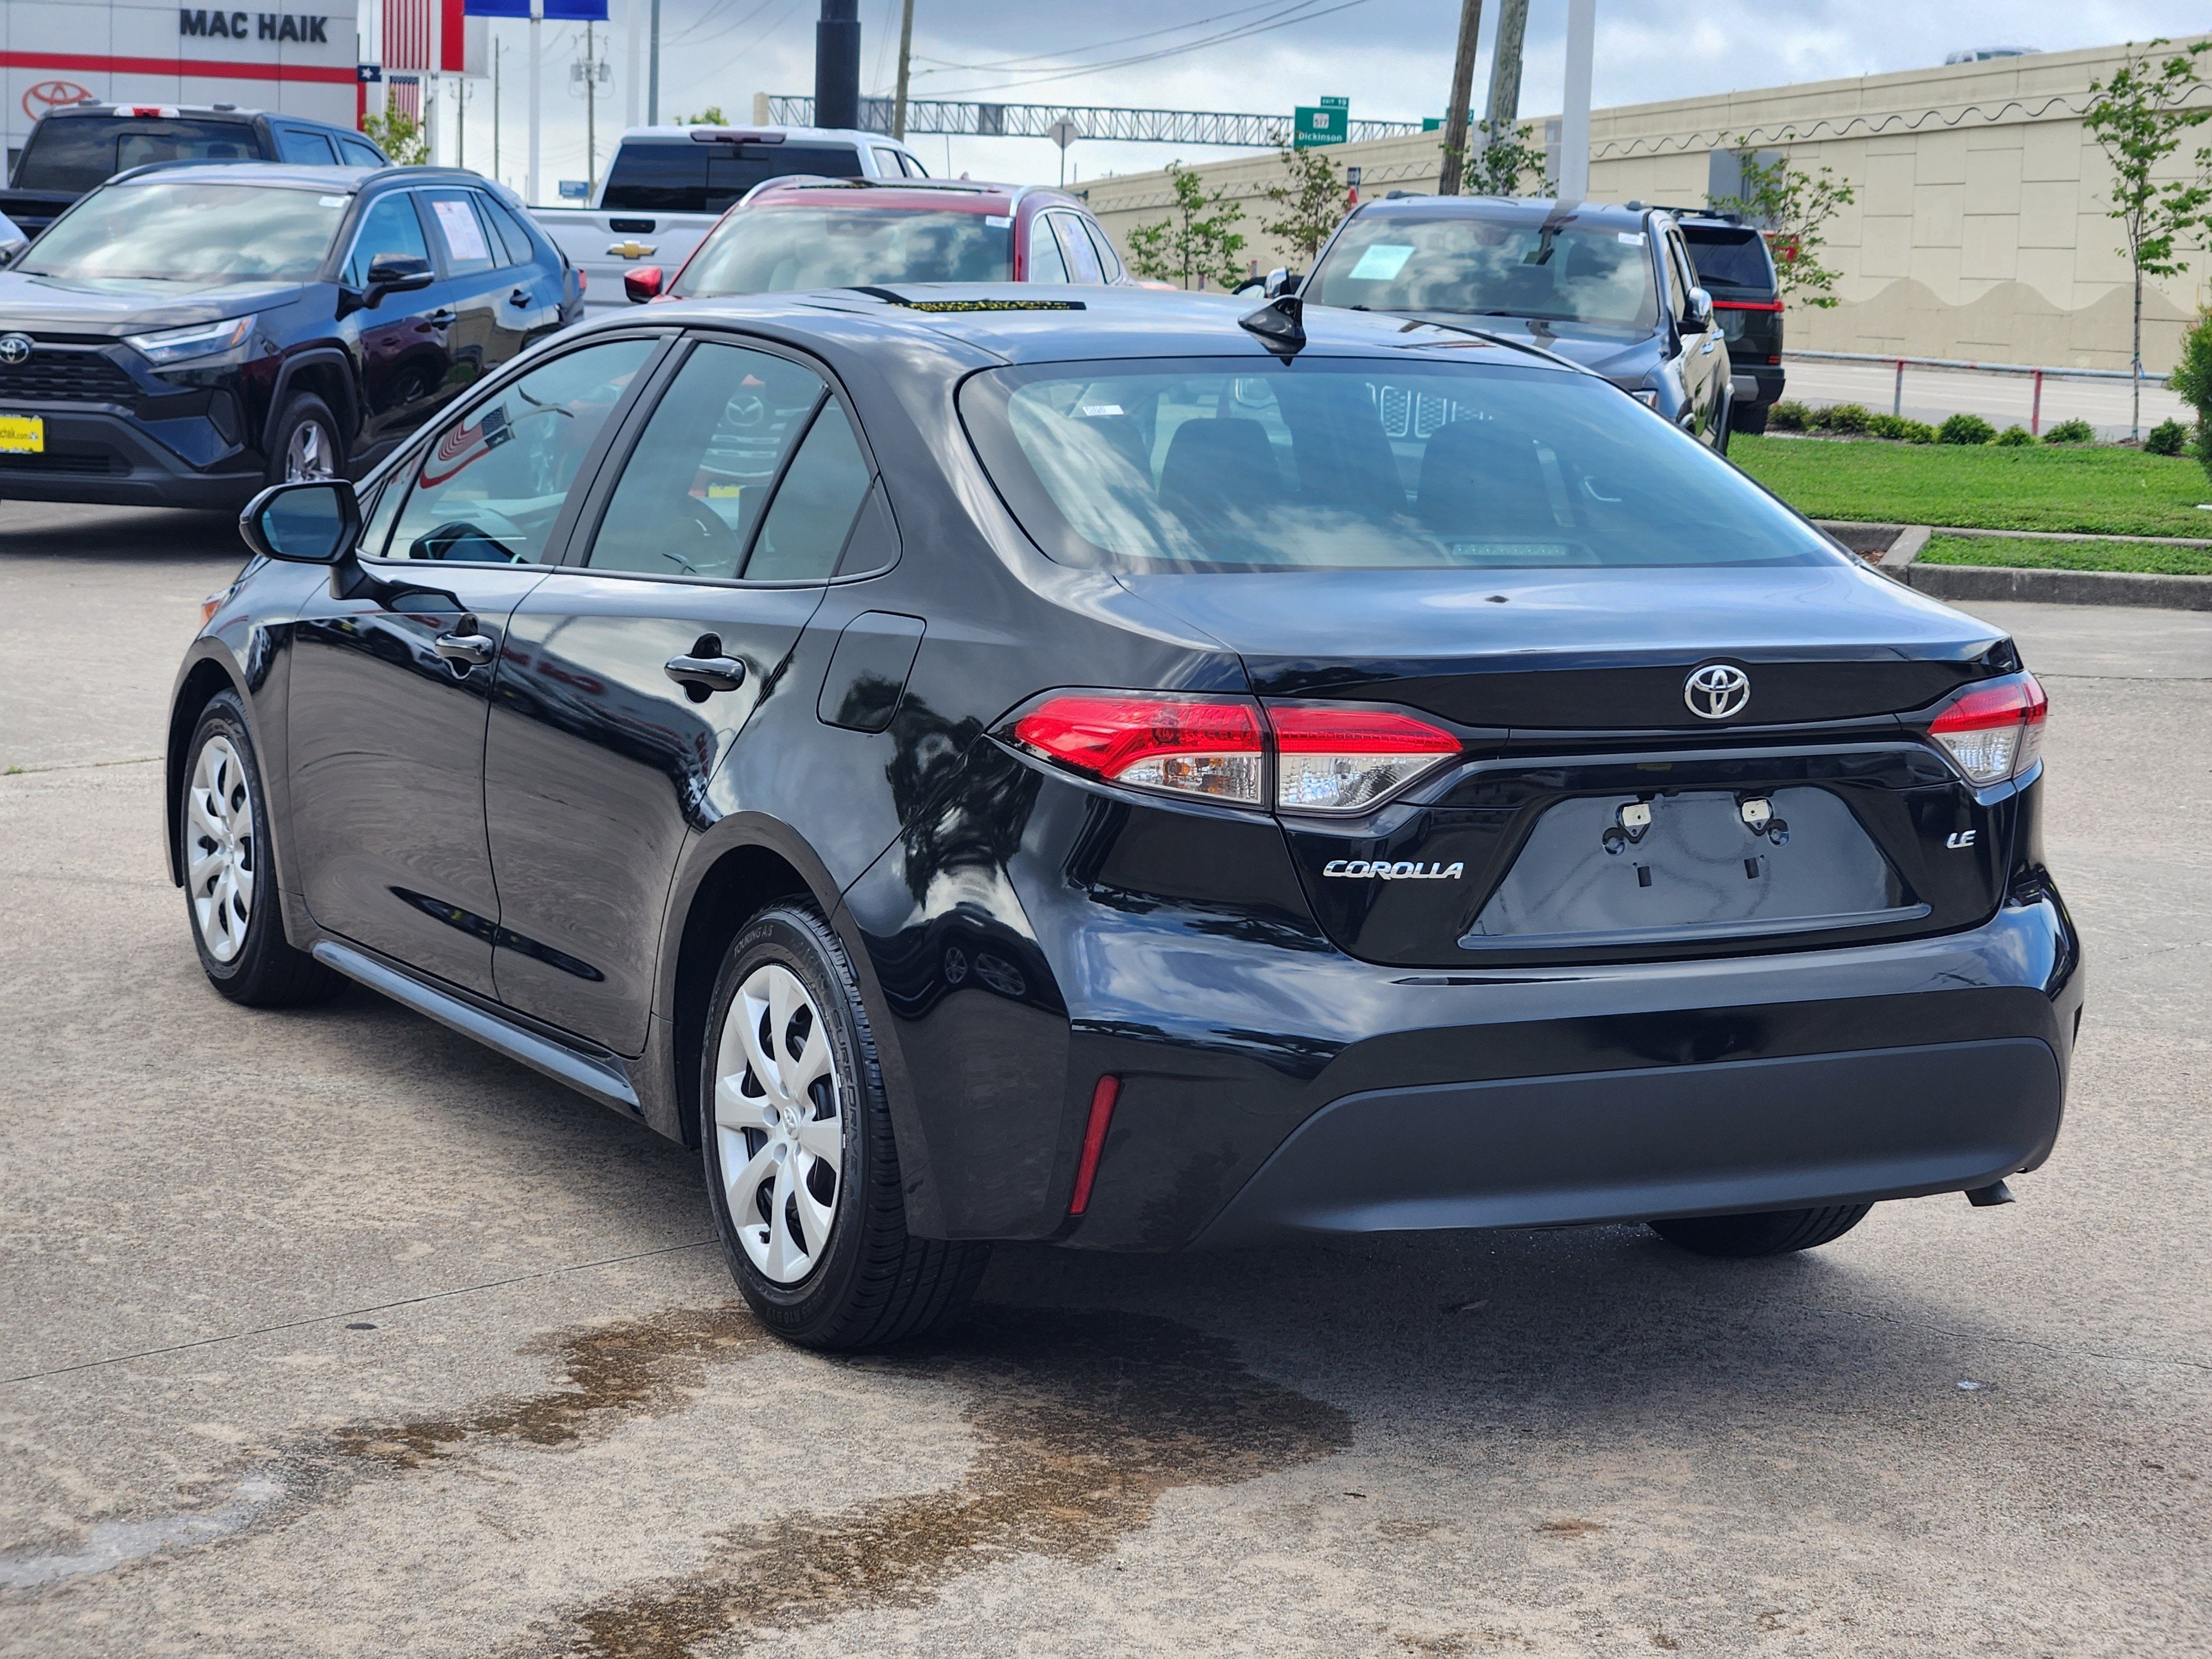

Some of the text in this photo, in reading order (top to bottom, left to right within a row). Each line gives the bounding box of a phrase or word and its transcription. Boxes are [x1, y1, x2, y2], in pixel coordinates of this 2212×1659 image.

[180, 9, 327, 43] MAC HAIK
[1314, 118, 1327, 127] 517
[1298, 132, 1343, 142] Dickinson
[1947, 830, 1976, 848] LE
[1323, 860, 1464, 880] COROLLA
[734, 926, 762, 957] TOURING
[833, 1008, 858, 1175] SUREDRIVE
